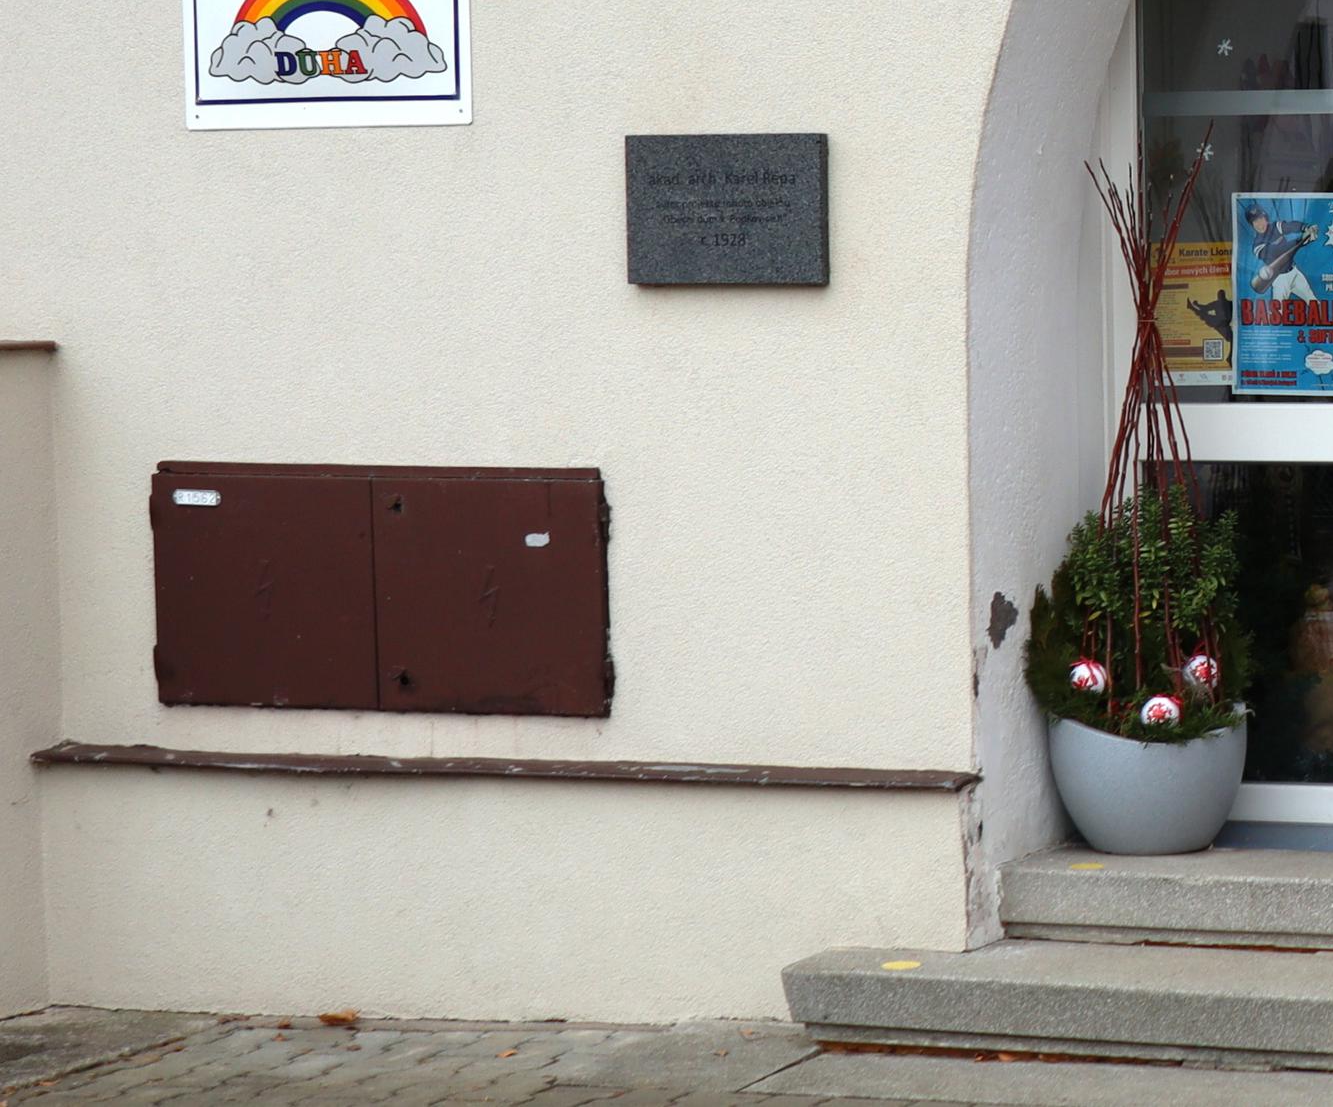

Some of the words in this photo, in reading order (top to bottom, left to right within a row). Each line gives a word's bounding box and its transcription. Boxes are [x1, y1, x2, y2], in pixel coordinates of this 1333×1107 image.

[273, 49, 369, 76] DUHA
[713, 232, 748, 246] 1928
[1178, 248, 1209, 256] Karate
[1296, 330, 1306, 343] &
